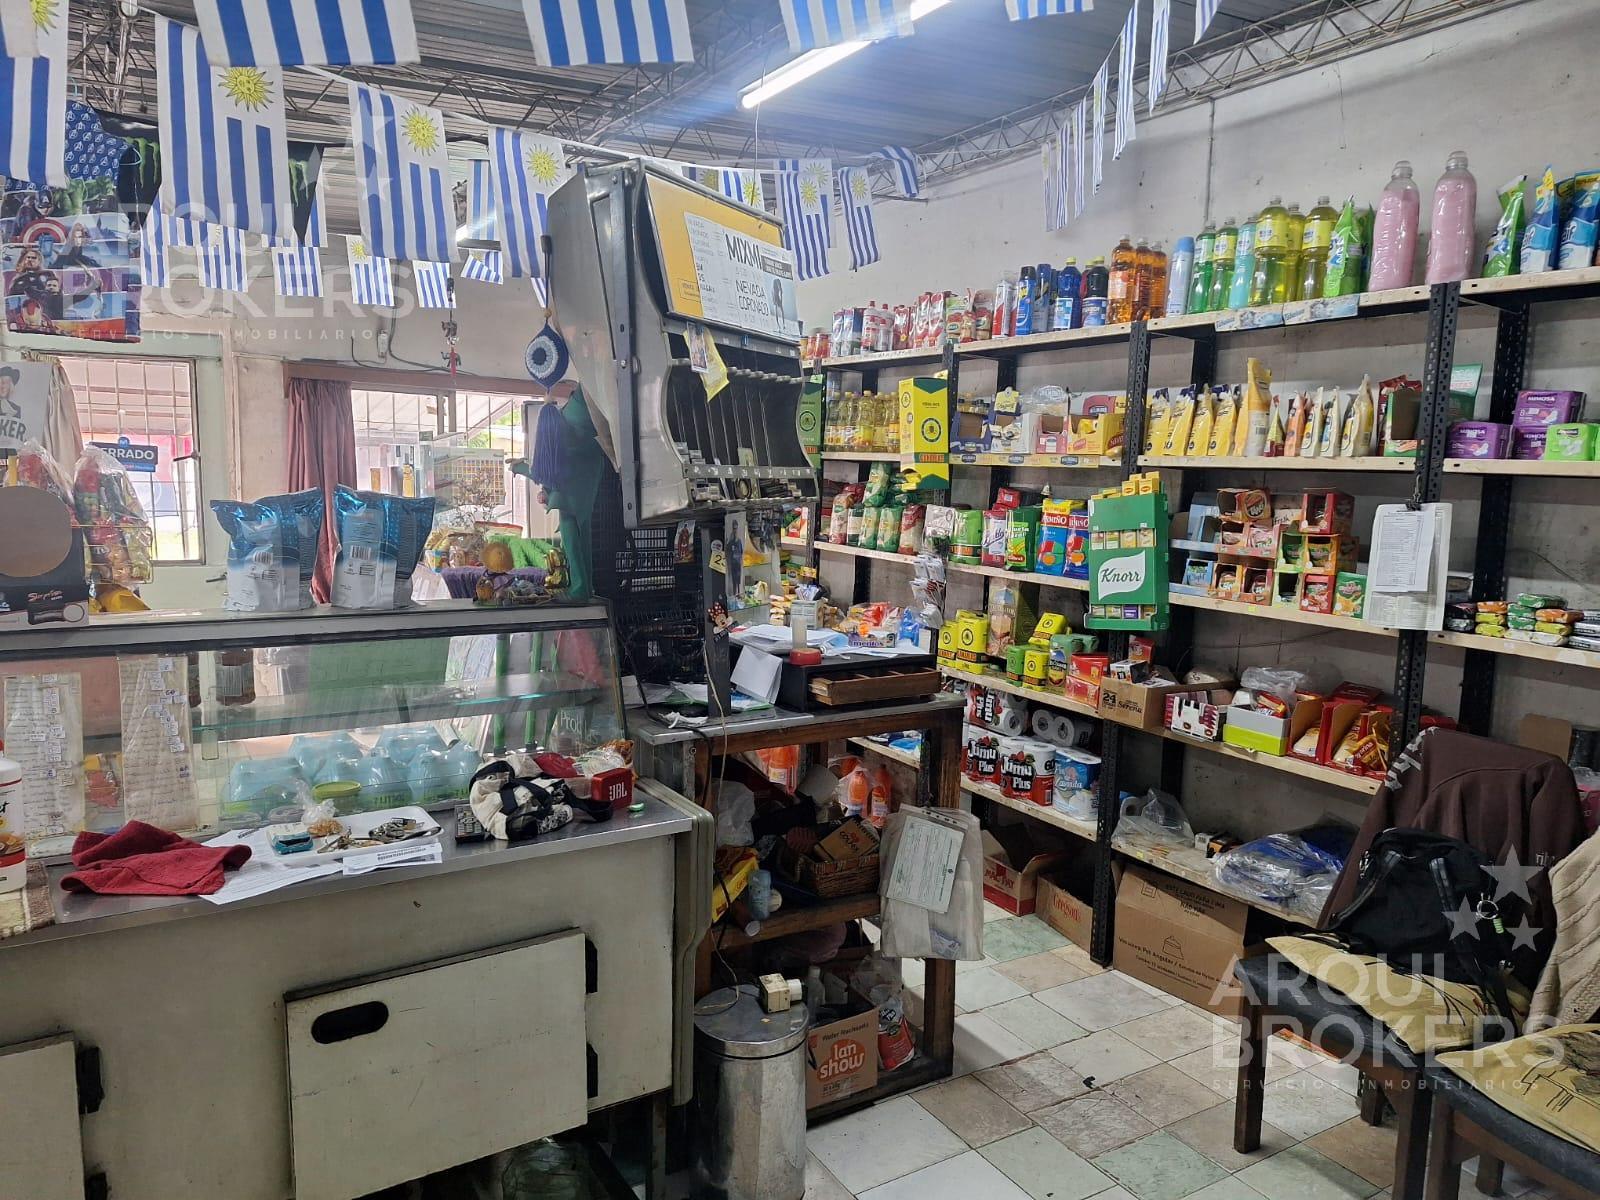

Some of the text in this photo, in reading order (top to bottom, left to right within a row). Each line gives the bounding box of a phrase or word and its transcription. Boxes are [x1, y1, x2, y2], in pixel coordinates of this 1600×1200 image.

[725, 233, 762, 270] MIXMI
[736, 280, 767, 300] NEVADA
[101, 447, 155, 460] ERRADO
[1101, 568, 1142, 584] Knorr
[1103, 692, 1116, 703] 24
[978, 760, 995, 774] Plus
[609, 782, 628, 801] JBL
[1012, 776, 1032, 791] Plus
[820, 1053, 865, 1080] show
